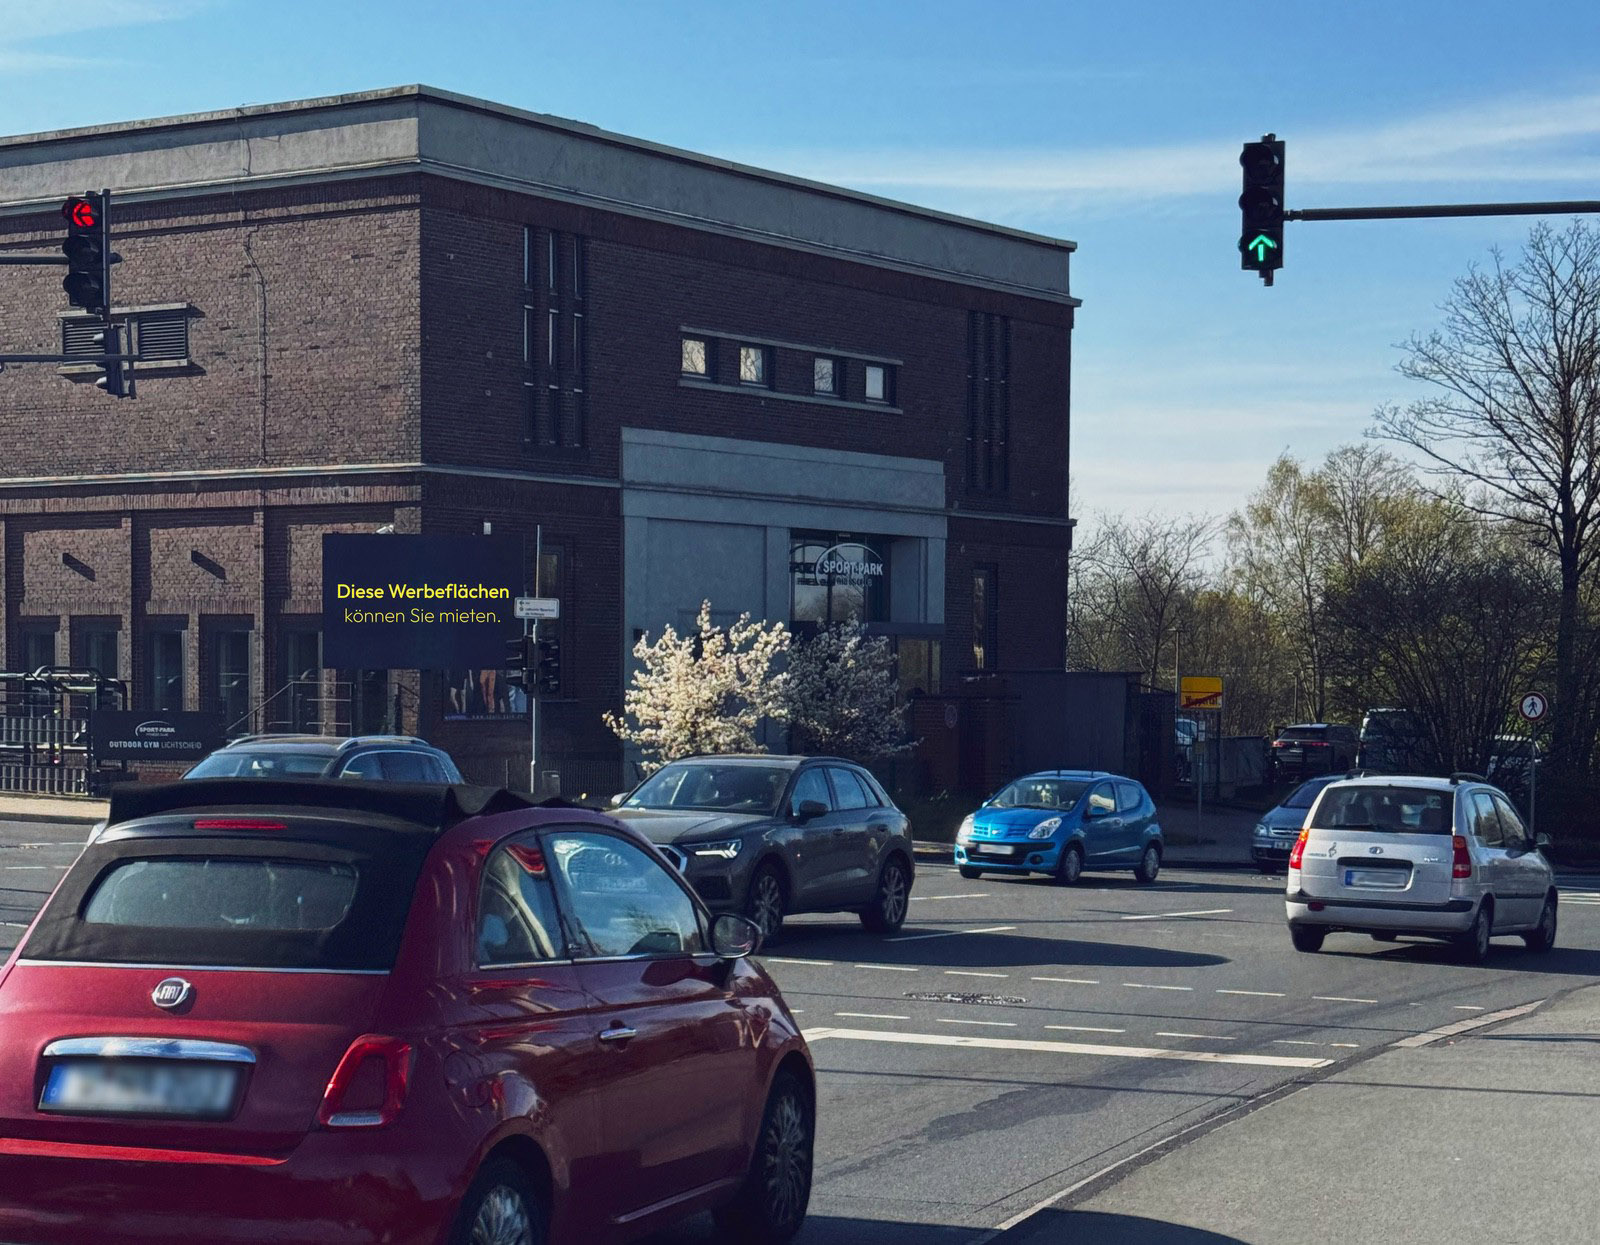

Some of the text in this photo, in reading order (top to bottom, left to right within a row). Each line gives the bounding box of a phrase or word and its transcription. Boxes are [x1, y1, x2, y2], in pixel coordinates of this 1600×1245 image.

[337, 583, 510, 599] Diese Werbeflächen
[344, 607, 501, 623] können Sie mieten.
[109, 740, 202, 750] OUTDOOR GYM LICHTSCHEID
[159, 985, 182, 1000] FIAT
